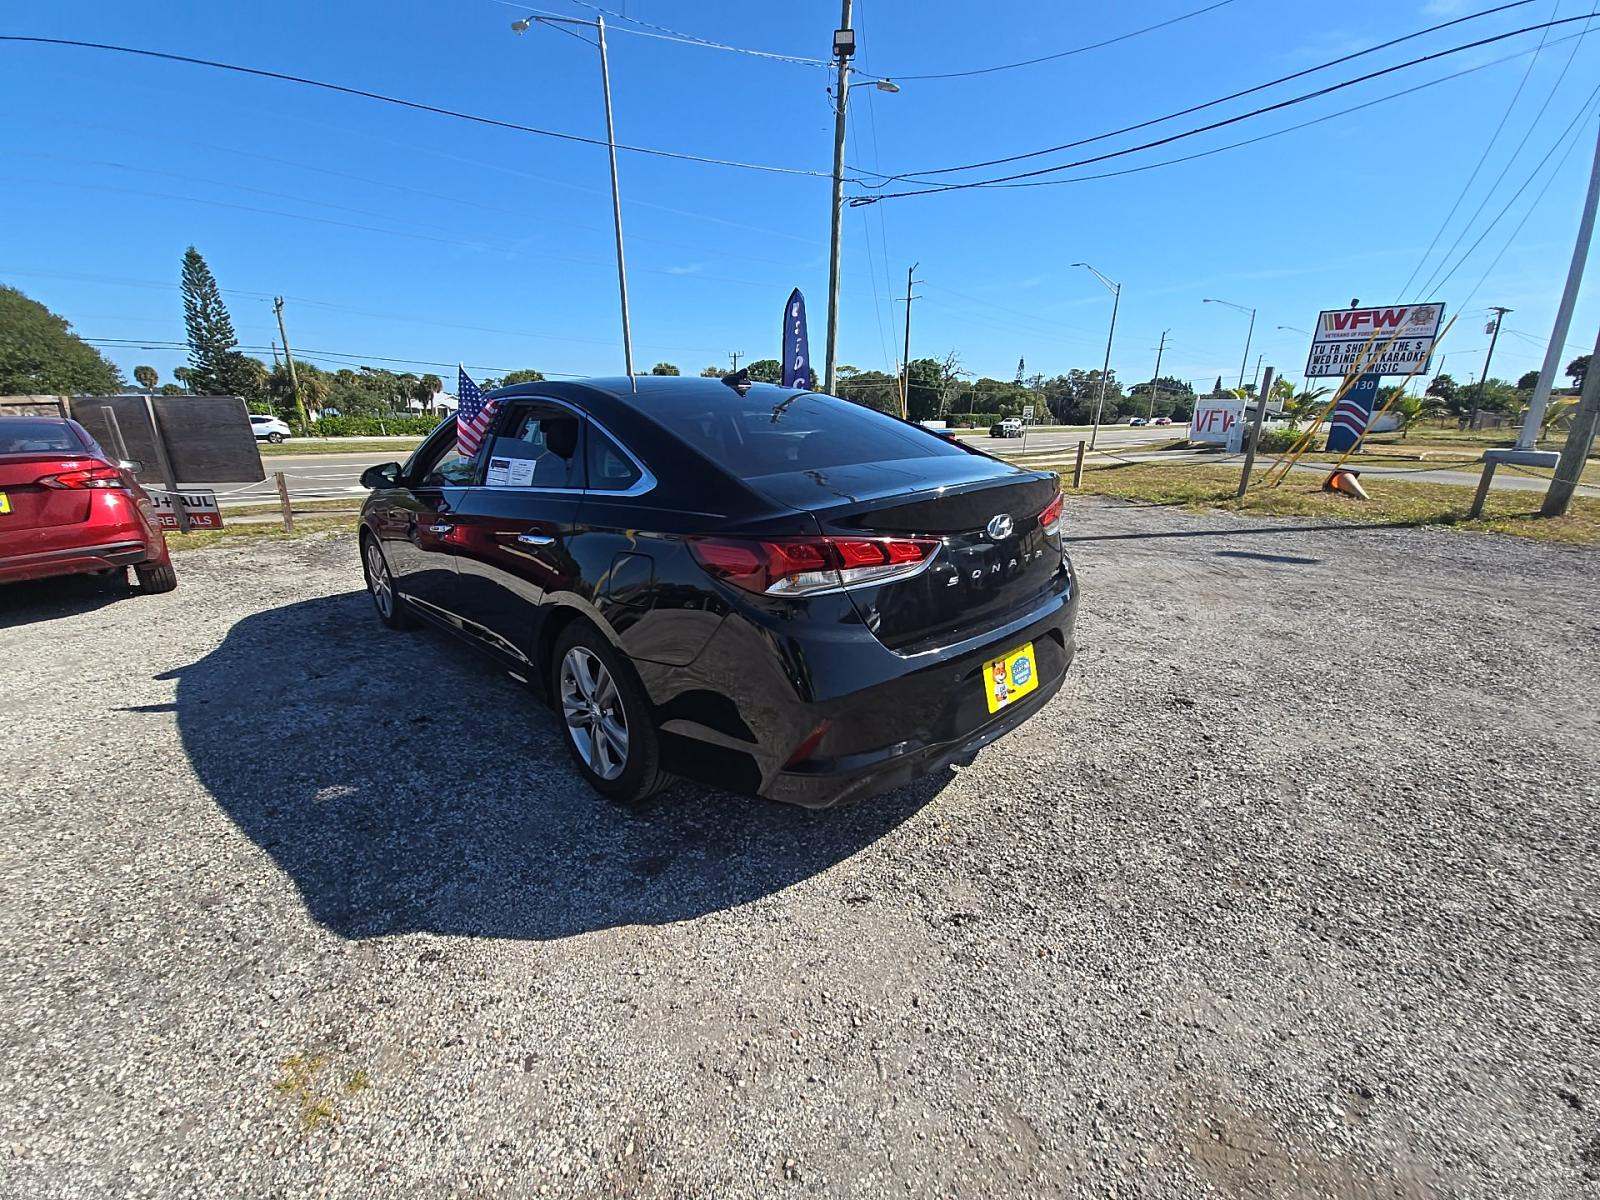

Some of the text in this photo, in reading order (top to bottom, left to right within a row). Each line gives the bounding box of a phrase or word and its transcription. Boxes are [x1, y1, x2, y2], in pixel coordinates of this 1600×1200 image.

[1334, 309, 1406, 330] VFW
[1314, 345, 1326, 355] TU
[1329, 344, 1341, 354] FR
[1392, 341, 1411, 352] THE
[1415, 341, 1423, 350] S
[1313, 354, 1332, 365] WED
[1380, 351, 1426, 362] KARAOKE
[1311, 364, 1331, 374] SAT
[1366, 362, 1399, 373] MUSIC
[159, 515, 213, 526] REALS
[947, 550, 1043, 586] SONATA
